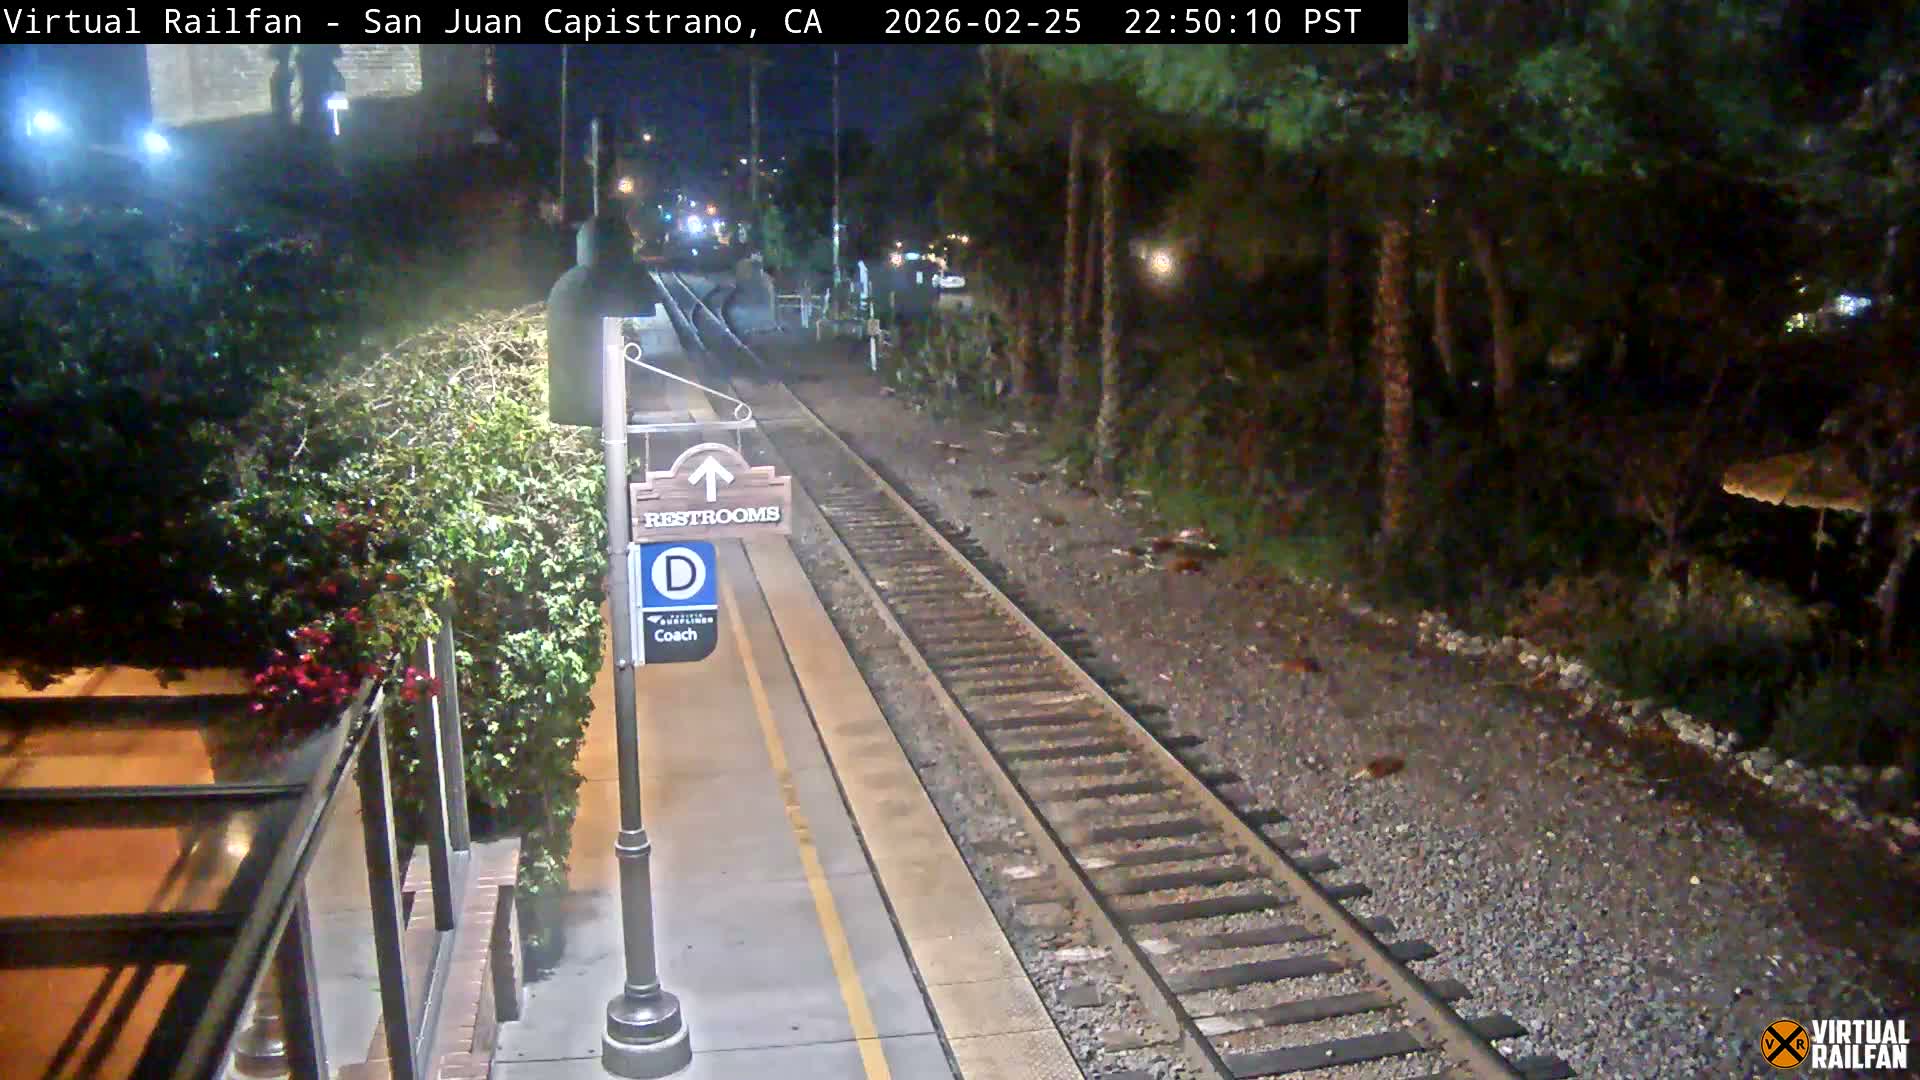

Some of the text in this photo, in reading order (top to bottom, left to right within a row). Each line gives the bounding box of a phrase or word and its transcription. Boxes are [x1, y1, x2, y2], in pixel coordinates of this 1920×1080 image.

[644, 507, 780, 528] RESTROOMS
[666, 555, 697, 591] D
[654, 627, 698, 642] Coach
